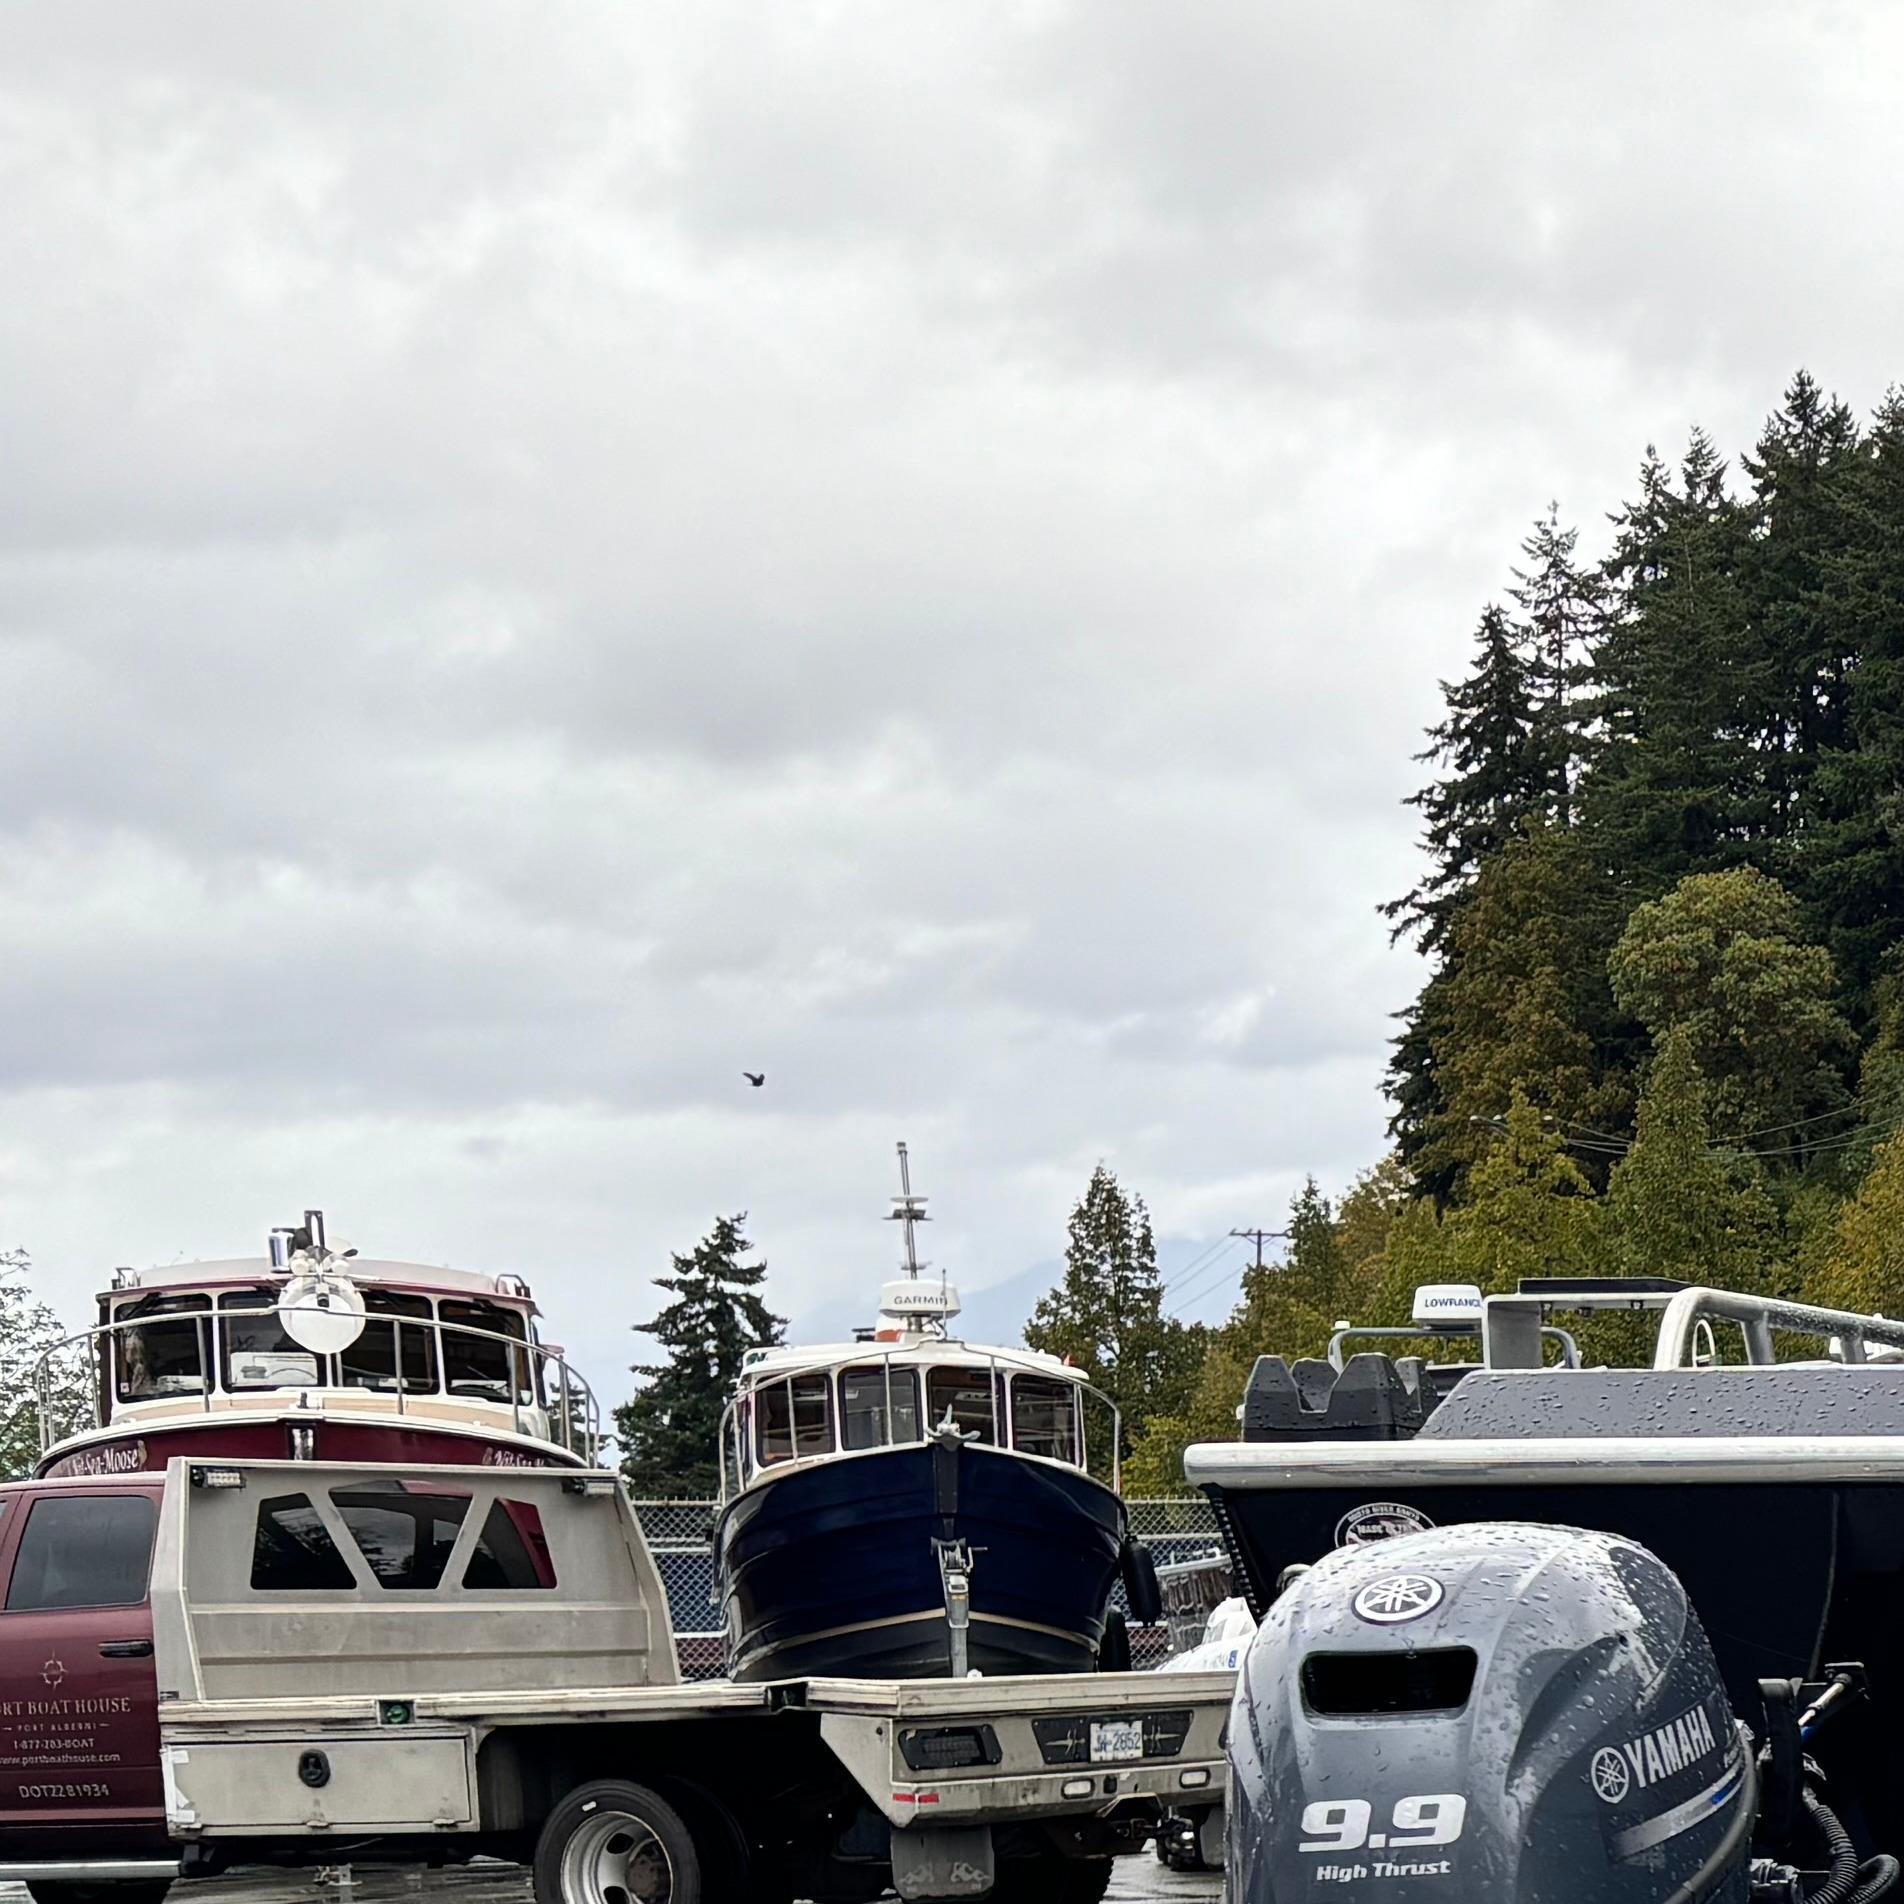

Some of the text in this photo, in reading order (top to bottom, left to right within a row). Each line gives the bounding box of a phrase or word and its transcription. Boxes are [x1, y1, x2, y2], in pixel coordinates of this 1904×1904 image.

[0, 1697, 131, 1716] RT BOAT HOUSE
[1623, 1705, 1716, 1788] YAMAHA
[1298, 1794, 1467, 1852] 9.9
[1316, 1860, 1451, 1883] High Thrust
